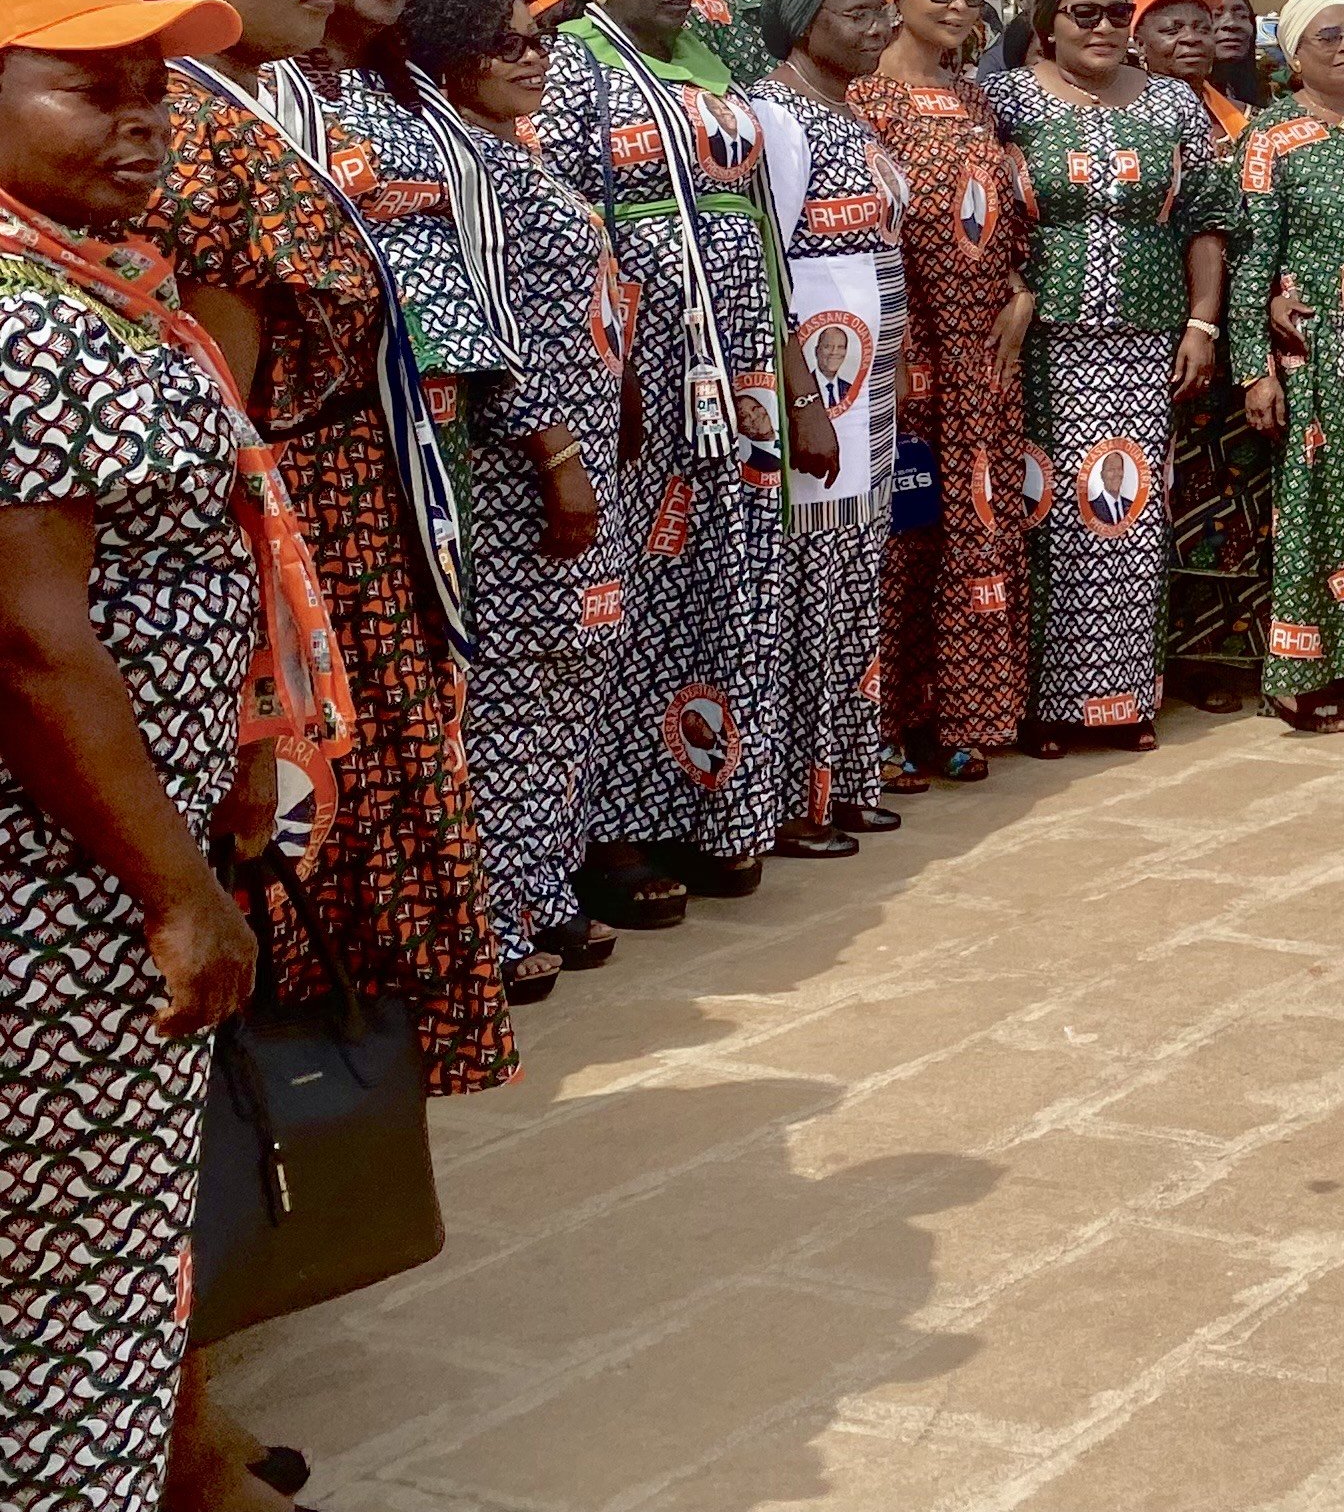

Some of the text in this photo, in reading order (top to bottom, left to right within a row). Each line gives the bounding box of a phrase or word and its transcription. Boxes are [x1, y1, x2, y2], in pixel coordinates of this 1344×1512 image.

[914, 94, 962, 112] RHDP
[611, 128, 664, 159] RHD
[1271, 120, 1319, 150] RHDP
[1248, 133, 1270, 189] RHDP
[811, 201, 877, 228] RHDP
[972, 582, 1007, 606] RHD
[1086, 700, 1137, 723] RHDP
